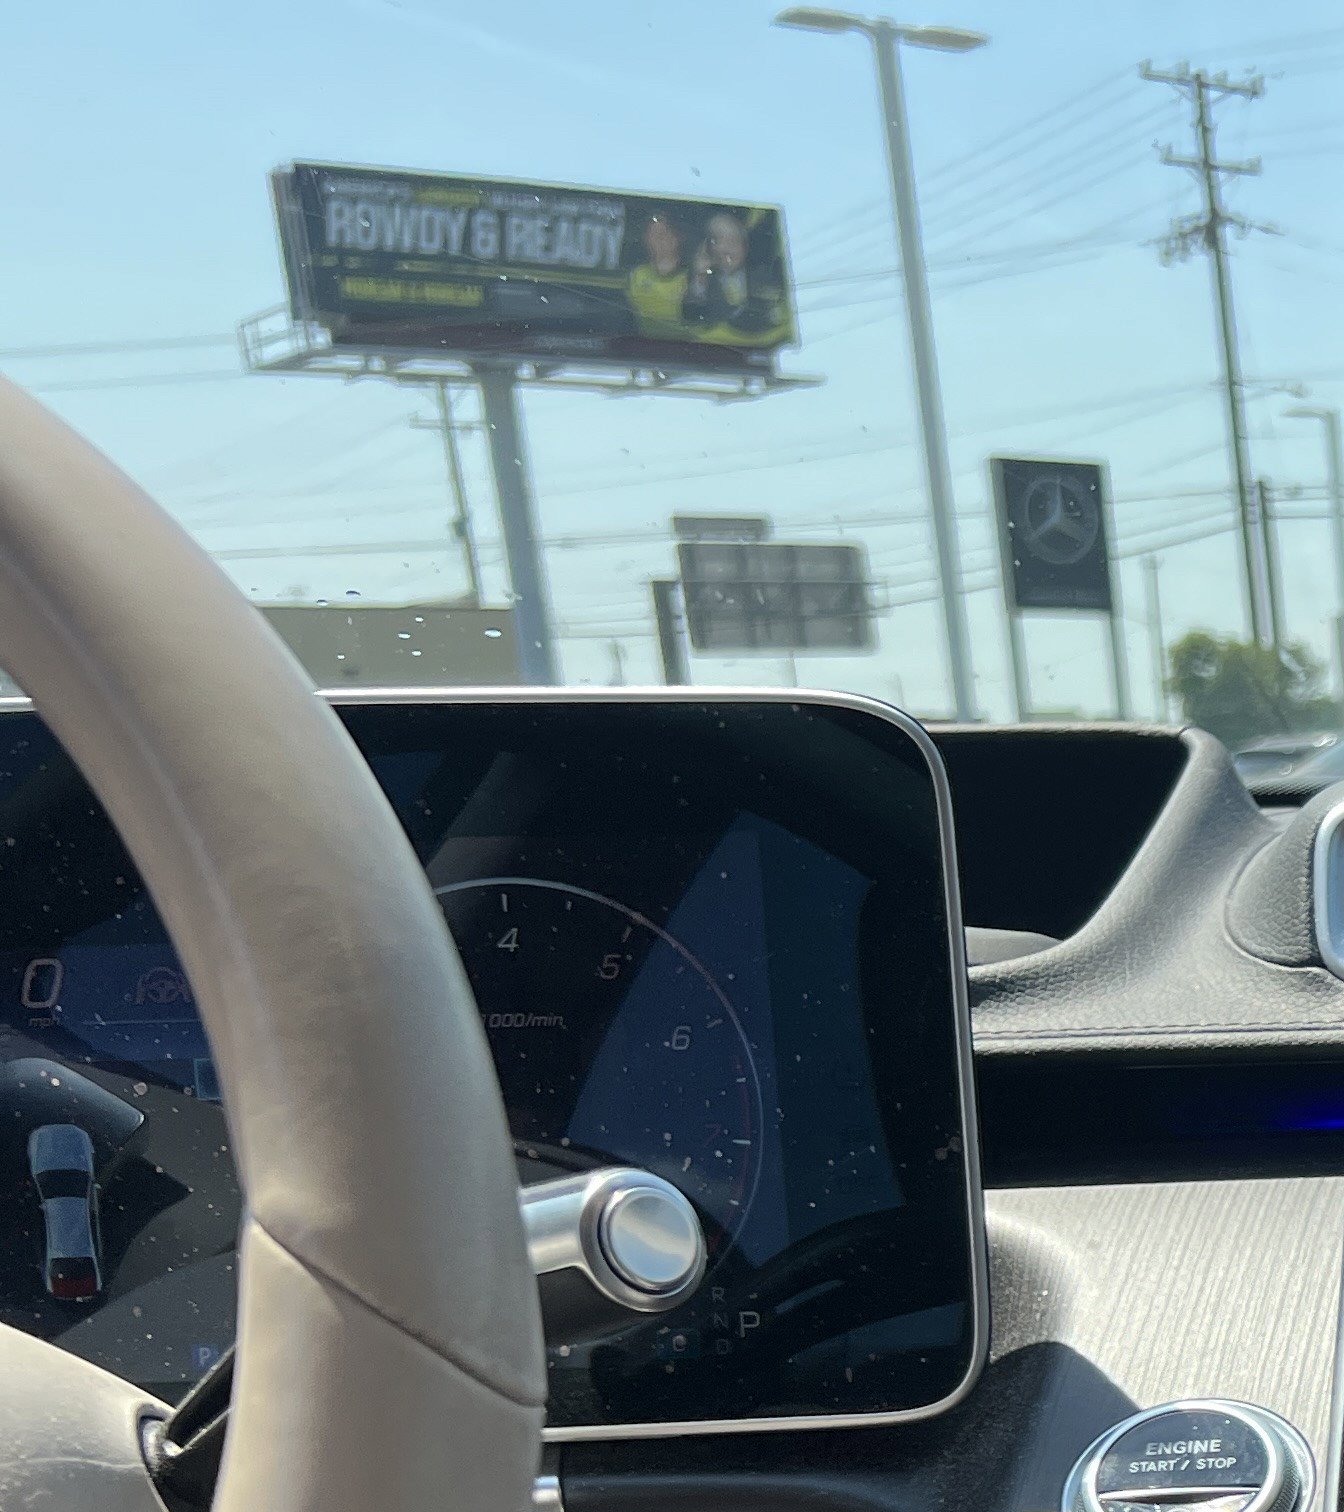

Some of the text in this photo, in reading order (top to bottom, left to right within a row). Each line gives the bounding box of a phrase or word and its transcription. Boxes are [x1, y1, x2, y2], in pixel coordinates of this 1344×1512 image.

[325, 199, 469, 256] ROWDY
[504, 212, 625, 269] READY
[497, 927, 519, 952] 4
[599, 953, 622, 980] 5
[21, 958, 65, 1009] 0
[671, 1025, 692, 1051] 6
[738, 1310, 761, 1338] P
[1145, 1438, 1222, 1456] ENGINE
[1129, 1459, 1176, 1474] START
[1195, 1456, 1237, 1470] STOP
